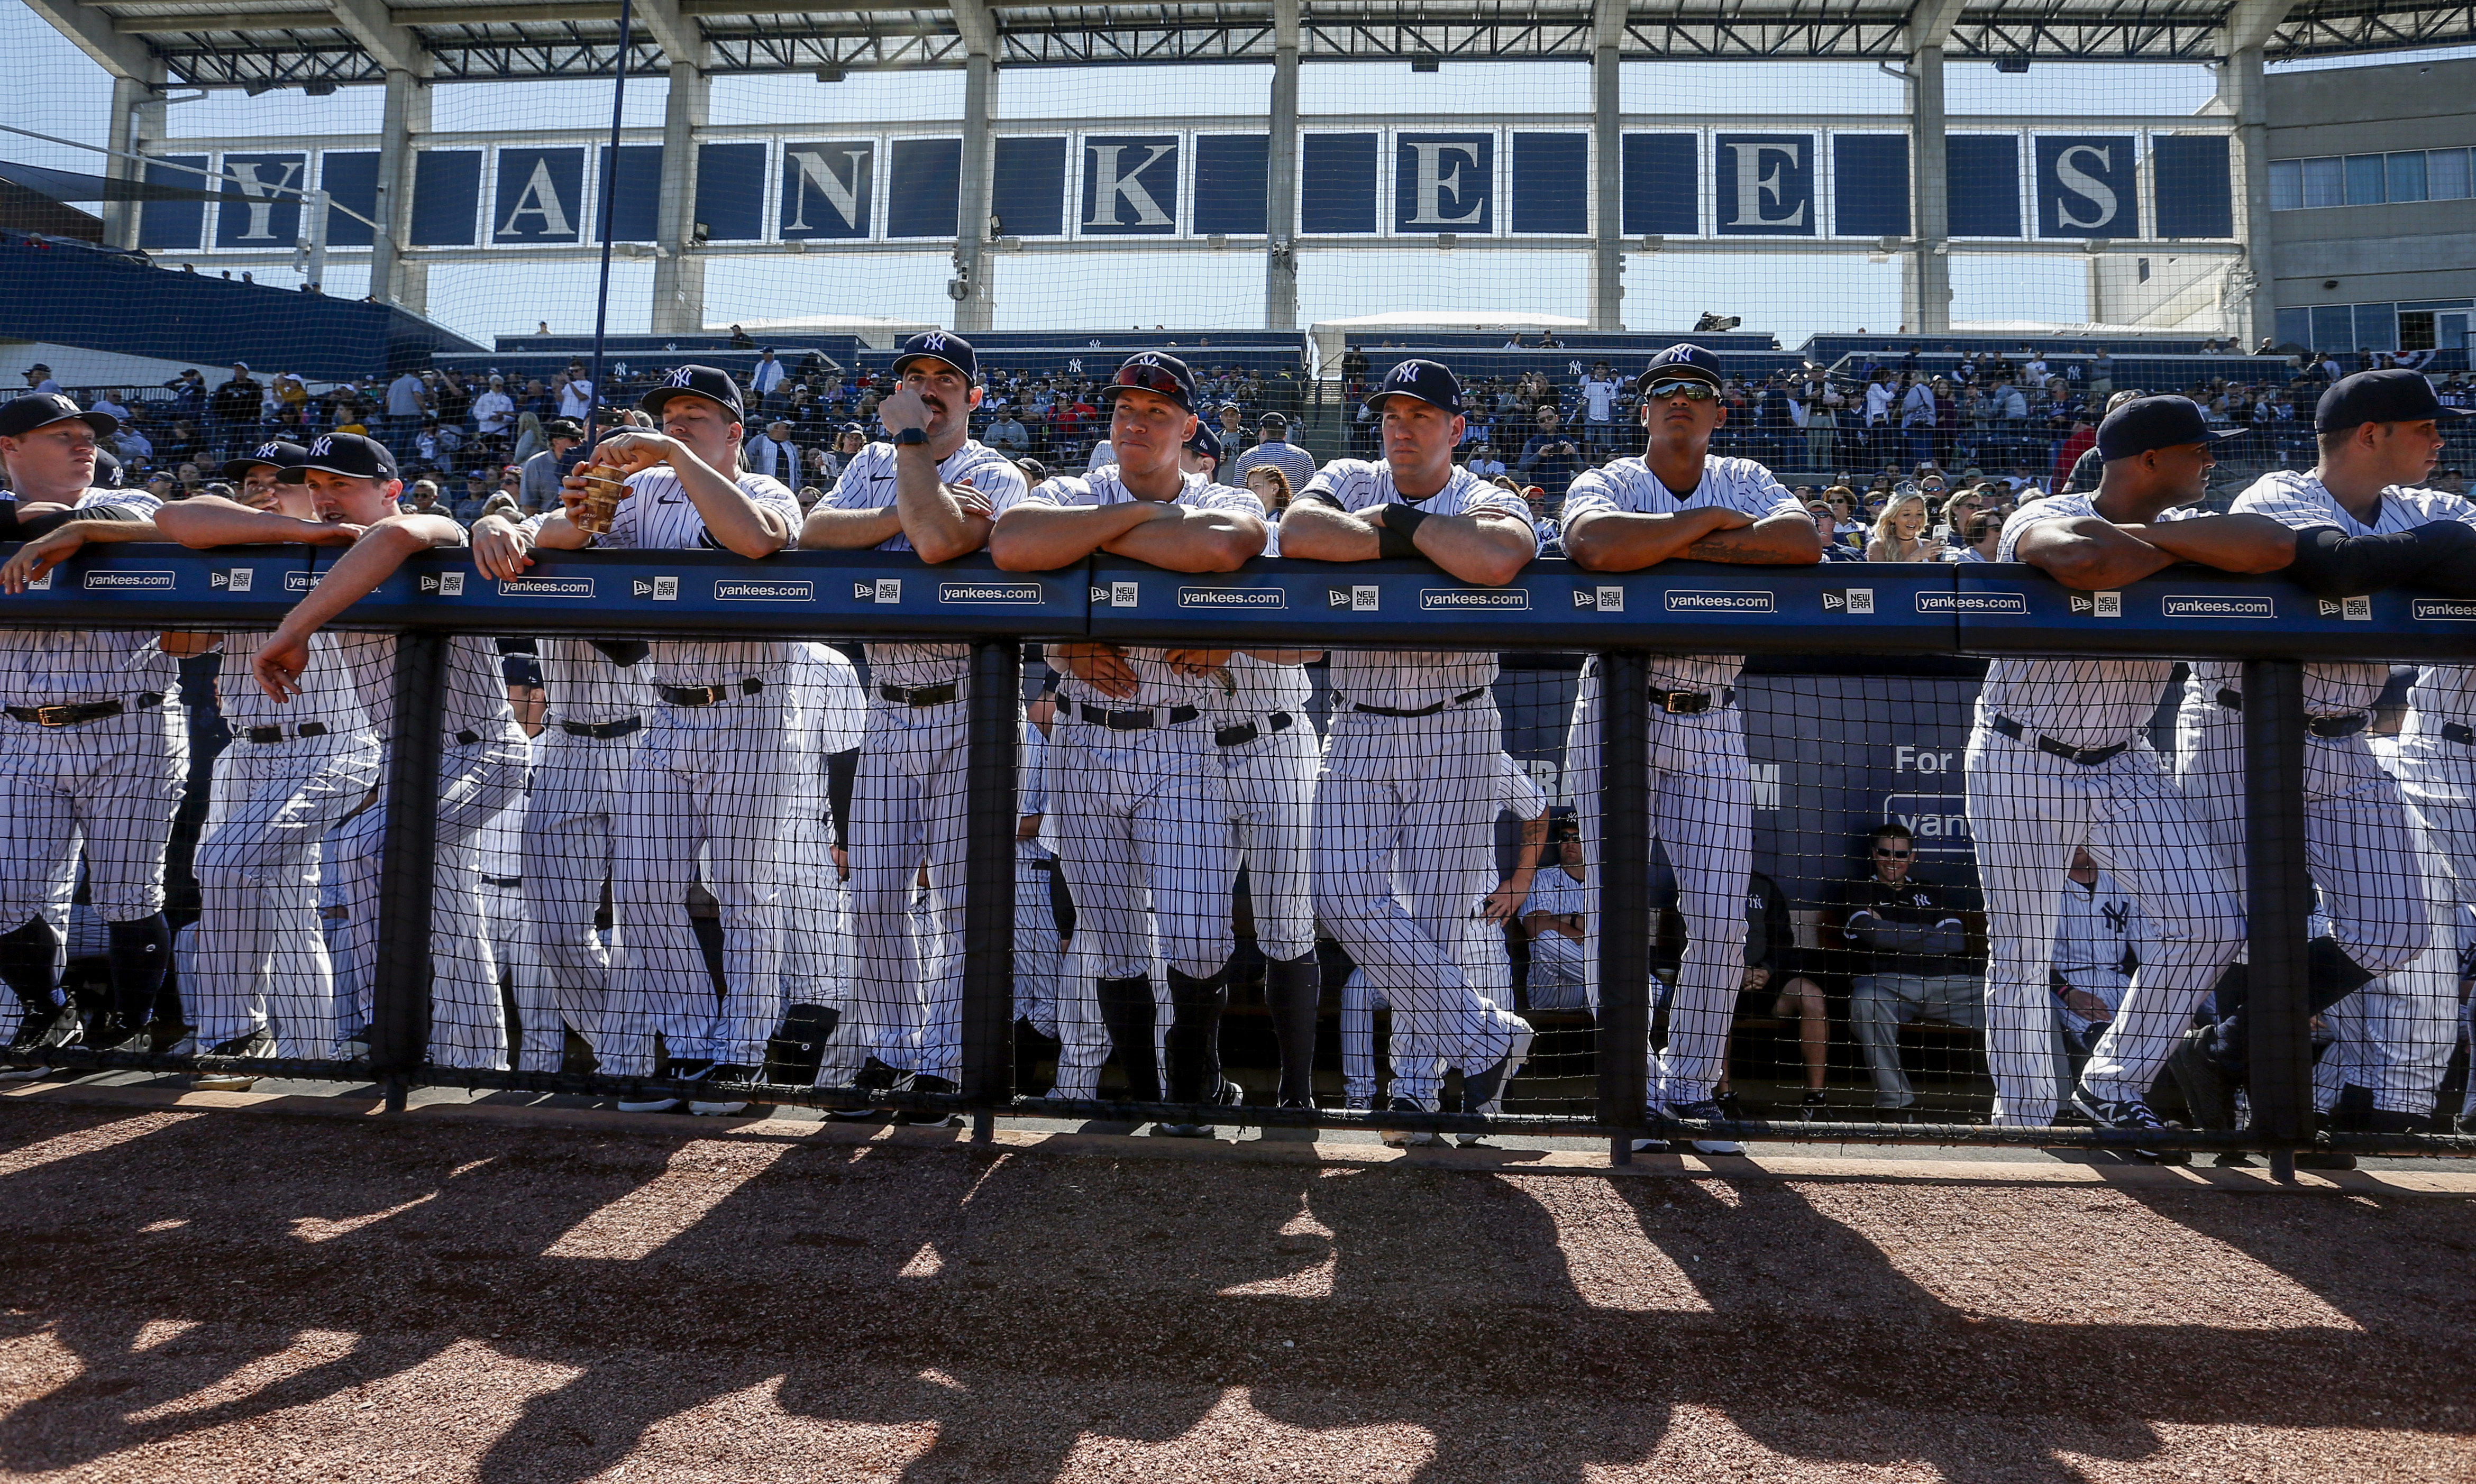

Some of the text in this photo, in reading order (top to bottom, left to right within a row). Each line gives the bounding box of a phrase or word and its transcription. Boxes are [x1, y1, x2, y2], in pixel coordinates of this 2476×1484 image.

[88, 575, 170, 586] yankees.com
[502, 581, 589, 593] yankees.com
[719, 584, 808, 597] yankees.com
[944, 588, 1037, 600] yankees.com
[1183, 591, 1280, 605] yankees.com
[1425, 593, 1523, 606] yankees.com
[1670, 595, 1768, 608] yankees.com
[1921, 597, 2021, 609] yankees.com
[2168, 600, 2268, 613] yankees.com
[1896, 746, 1952, 774] For
